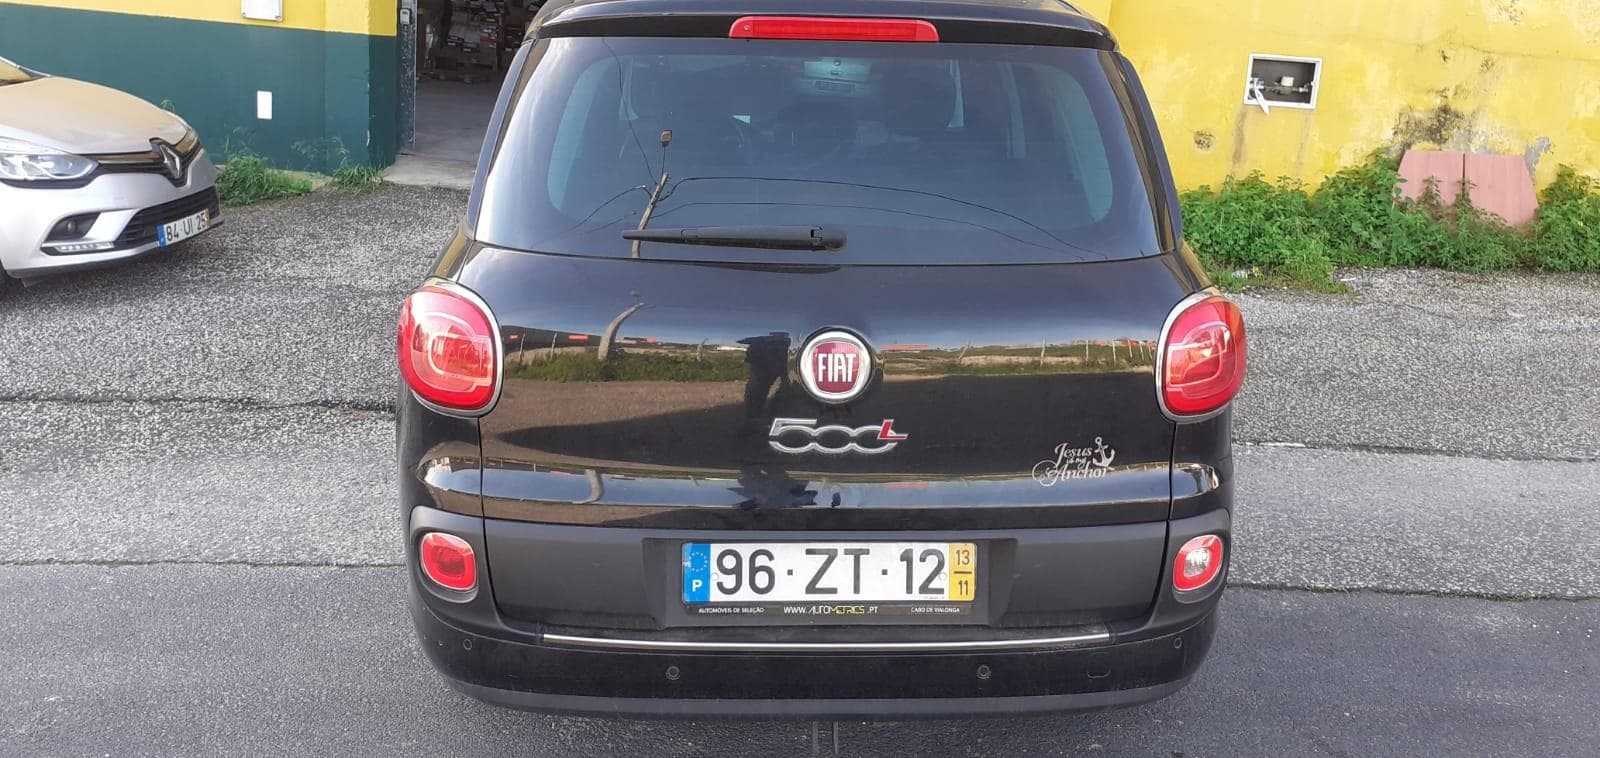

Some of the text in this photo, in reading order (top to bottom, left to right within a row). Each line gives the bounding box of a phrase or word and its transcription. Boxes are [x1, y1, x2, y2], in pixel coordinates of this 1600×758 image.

[817, 353, 857, 383] FIAT
[1054, 443, 1093, 468] Jesus
[1075, 456, 1087, 468] my
[1040, 461, 1107, 486] Anchor
[956, 549, 970, 565] 13
[692, 580, 702, 592] P
[957, 580, 969, 596] 11
